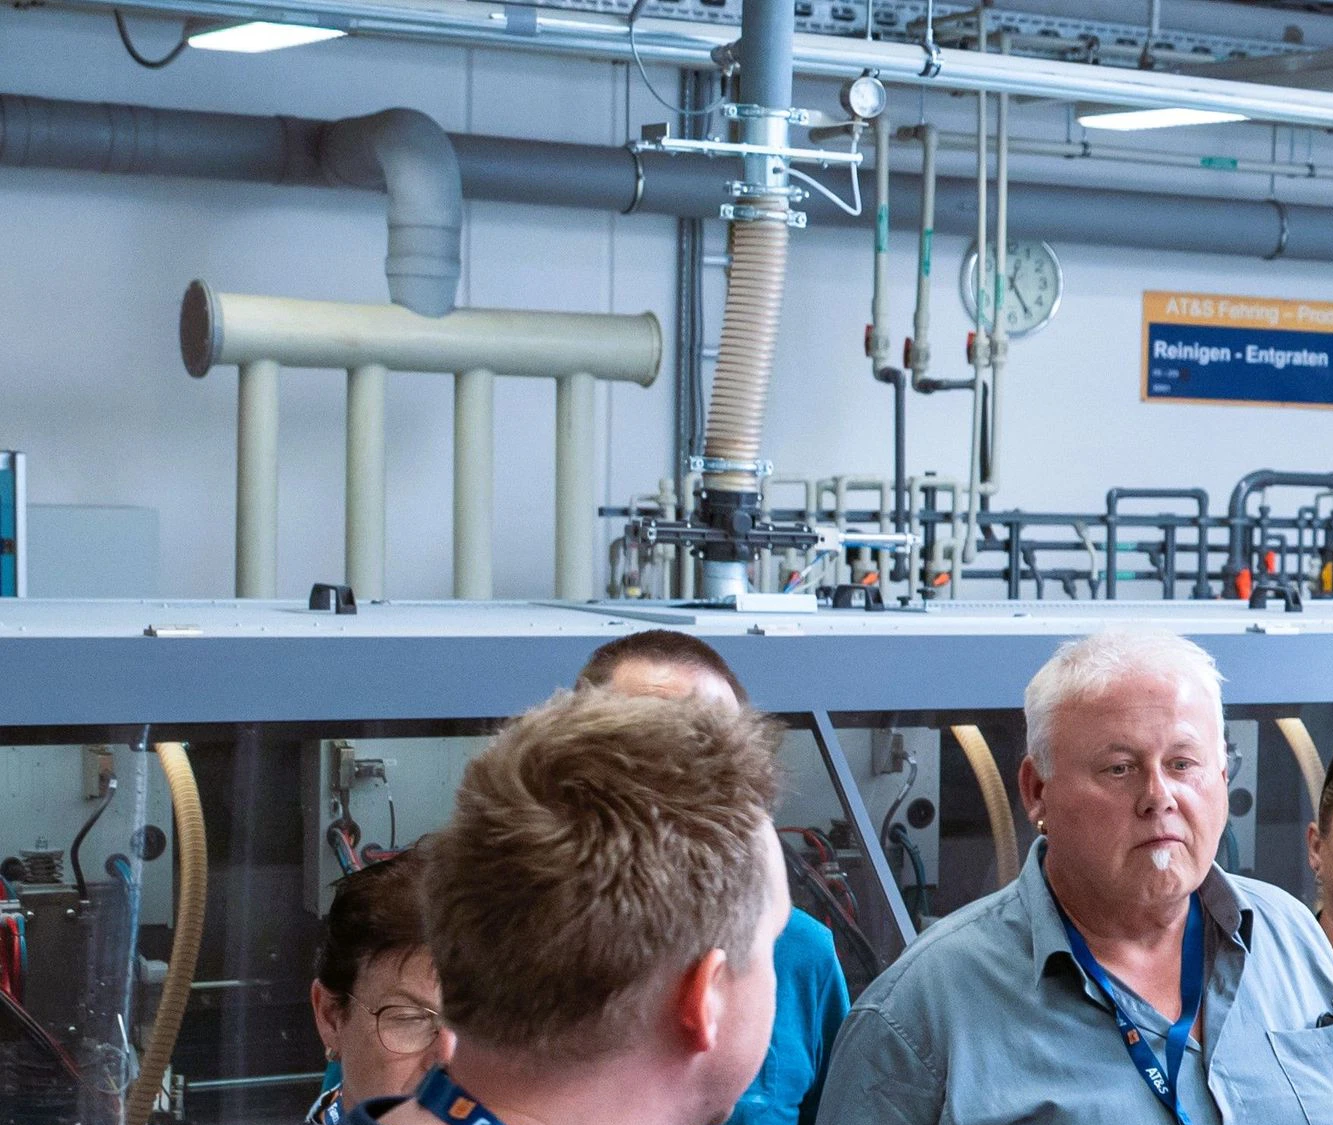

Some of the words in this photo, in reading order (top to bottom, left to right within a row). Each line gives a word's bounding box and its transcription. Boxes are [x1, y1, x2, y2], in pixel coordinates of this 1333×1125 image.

[1166, 296, 1214, 318] AT&S
[1154, 340, 1231, 366] Reinigen
[1245, 344, 1329, 369] Entgraten
[1145, 1067, 1169, 1095] AT&S
